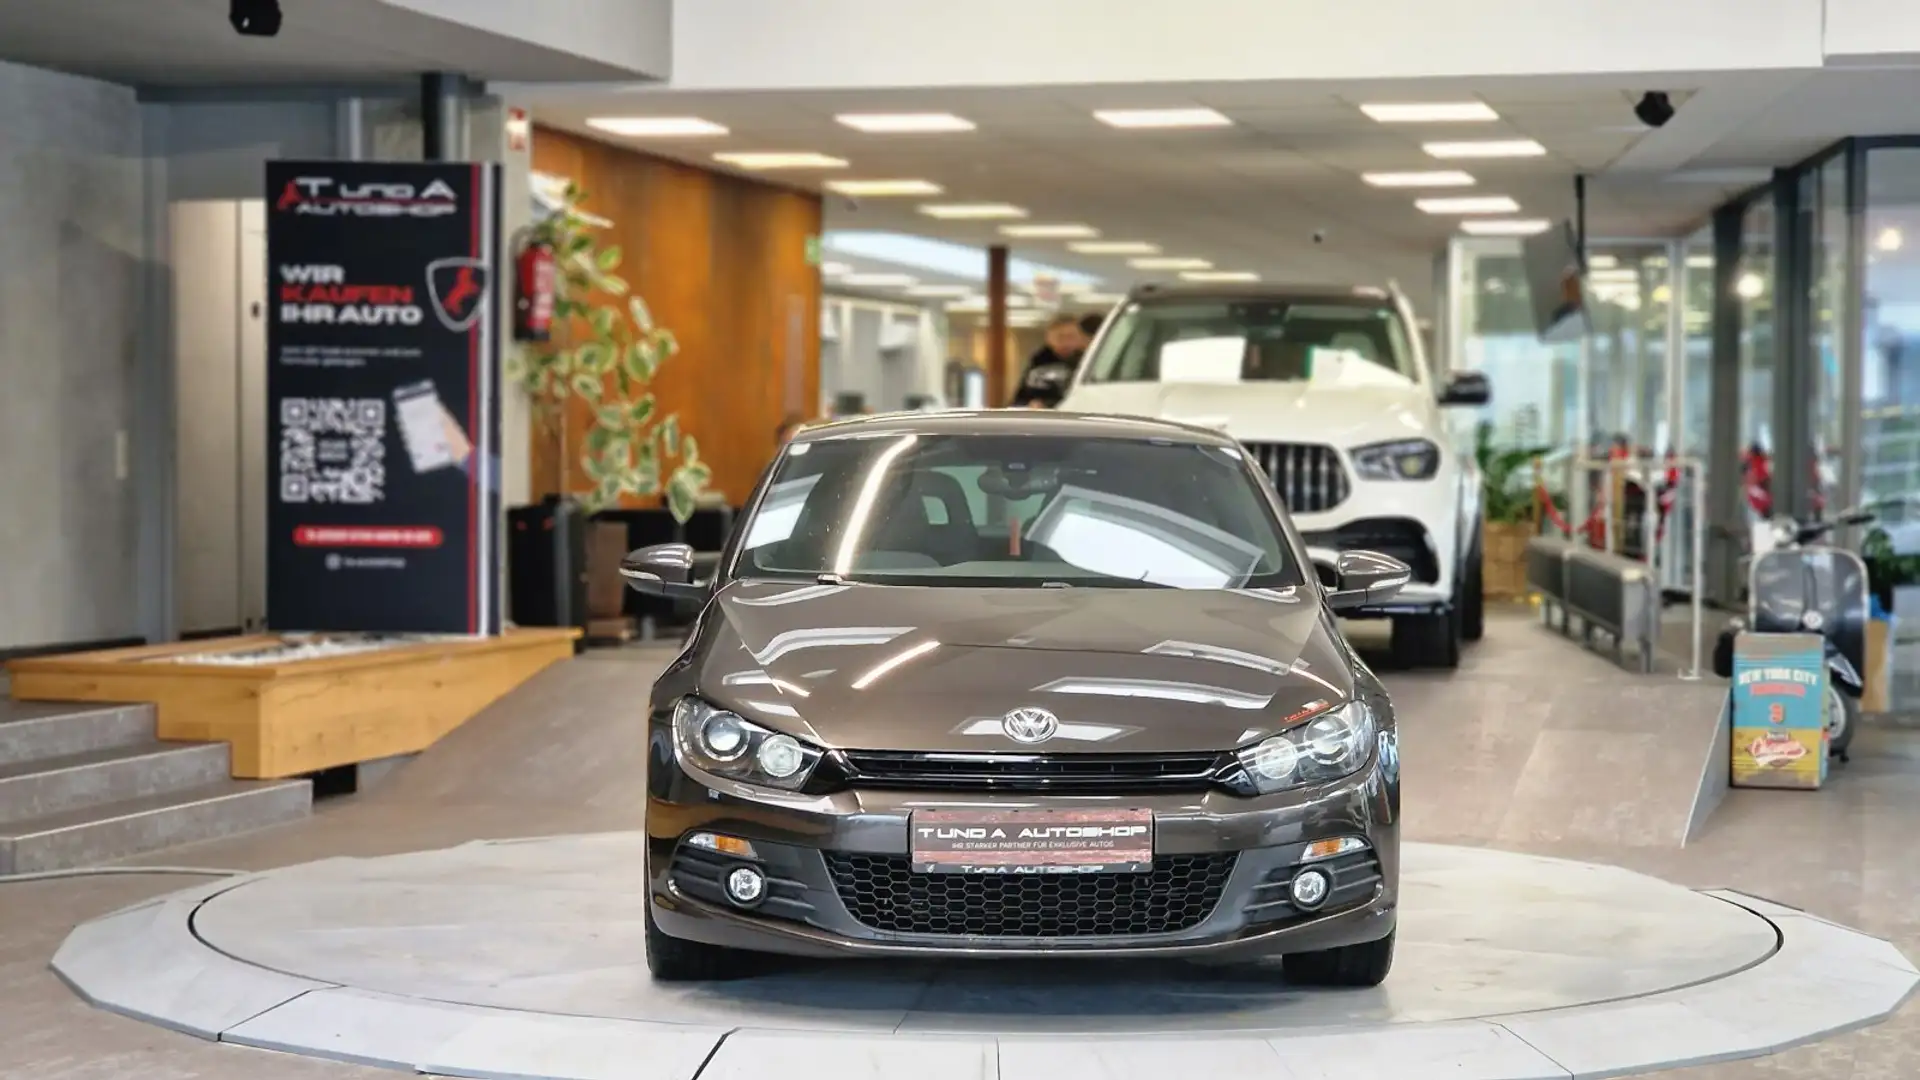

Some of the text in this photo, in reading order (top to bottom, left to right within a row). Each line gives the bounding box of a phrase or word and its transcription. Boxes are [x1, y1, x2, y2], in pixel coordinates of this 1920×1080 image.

[280, 264, 345, 283] WIR
[280, 285, 414, 303] KAUFEN
[1017, 825, 1147, 838] AUTOSHOP
[999, 841, 1031, 849] PARTNER
[1049, 840, 1087, 848] EXKLUSIVE
[1089, 840, 1115, 848] AUTOS
